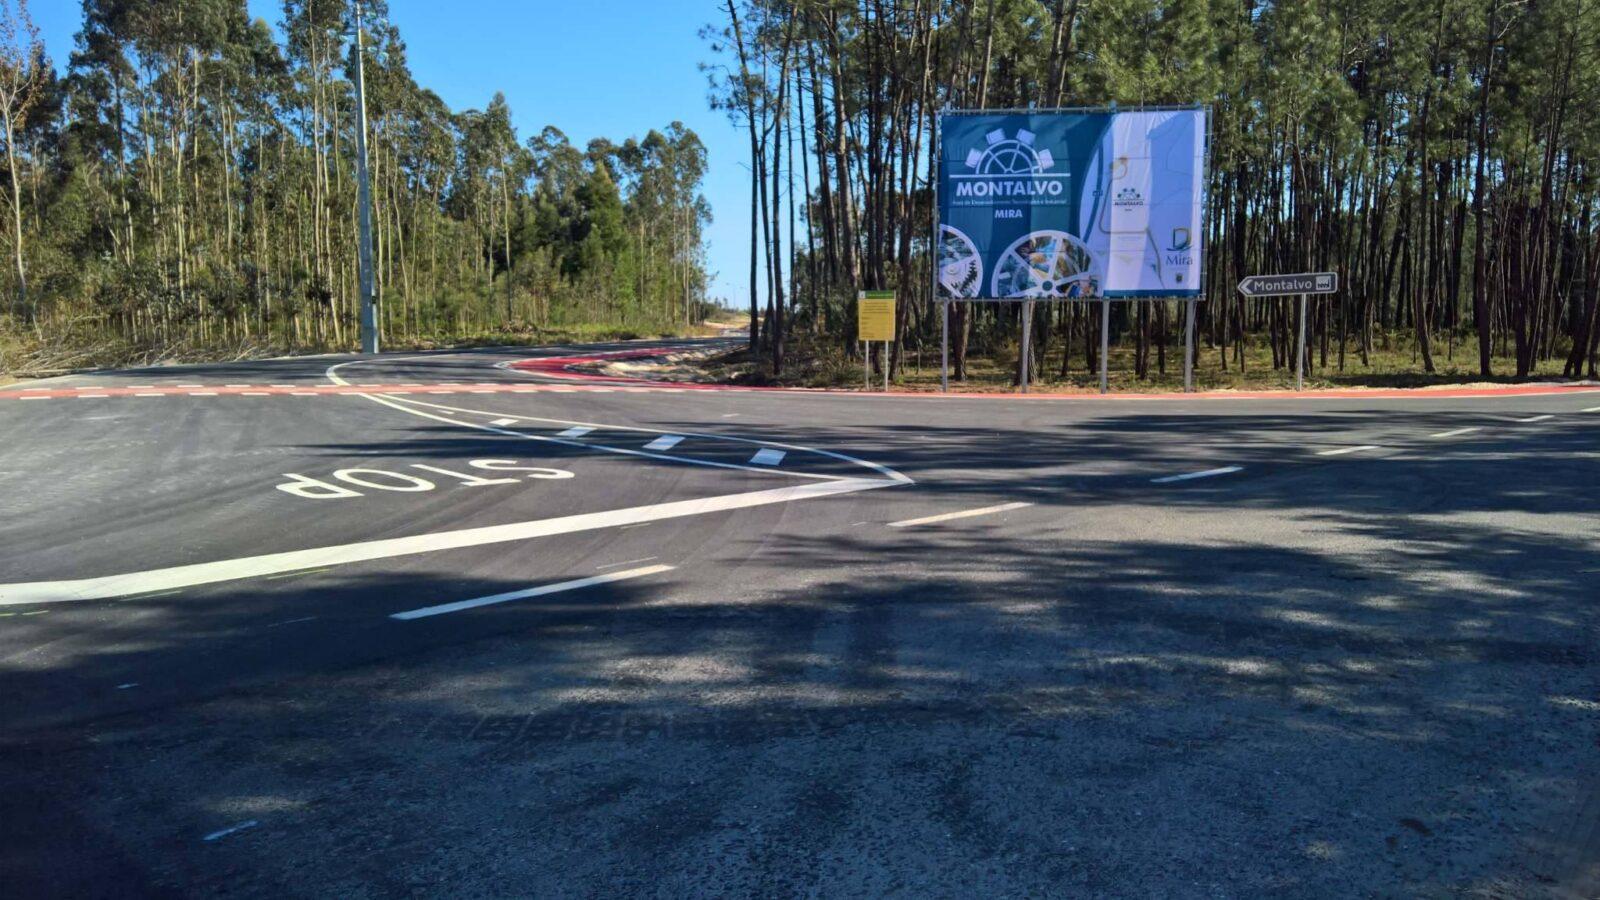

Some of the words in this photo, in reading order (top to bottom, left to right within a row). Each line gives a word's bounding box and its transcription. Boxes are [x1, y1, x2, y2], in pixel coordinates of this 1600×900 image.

[956, 181, 1063, 197] MONTALVO
[994, 209, 1023, 219] MIRA
[1166, 254, 1194, 266] Mira
[1253, 279, 1312, 292] Montalvo
[275, 459, 575, 499] STOP
